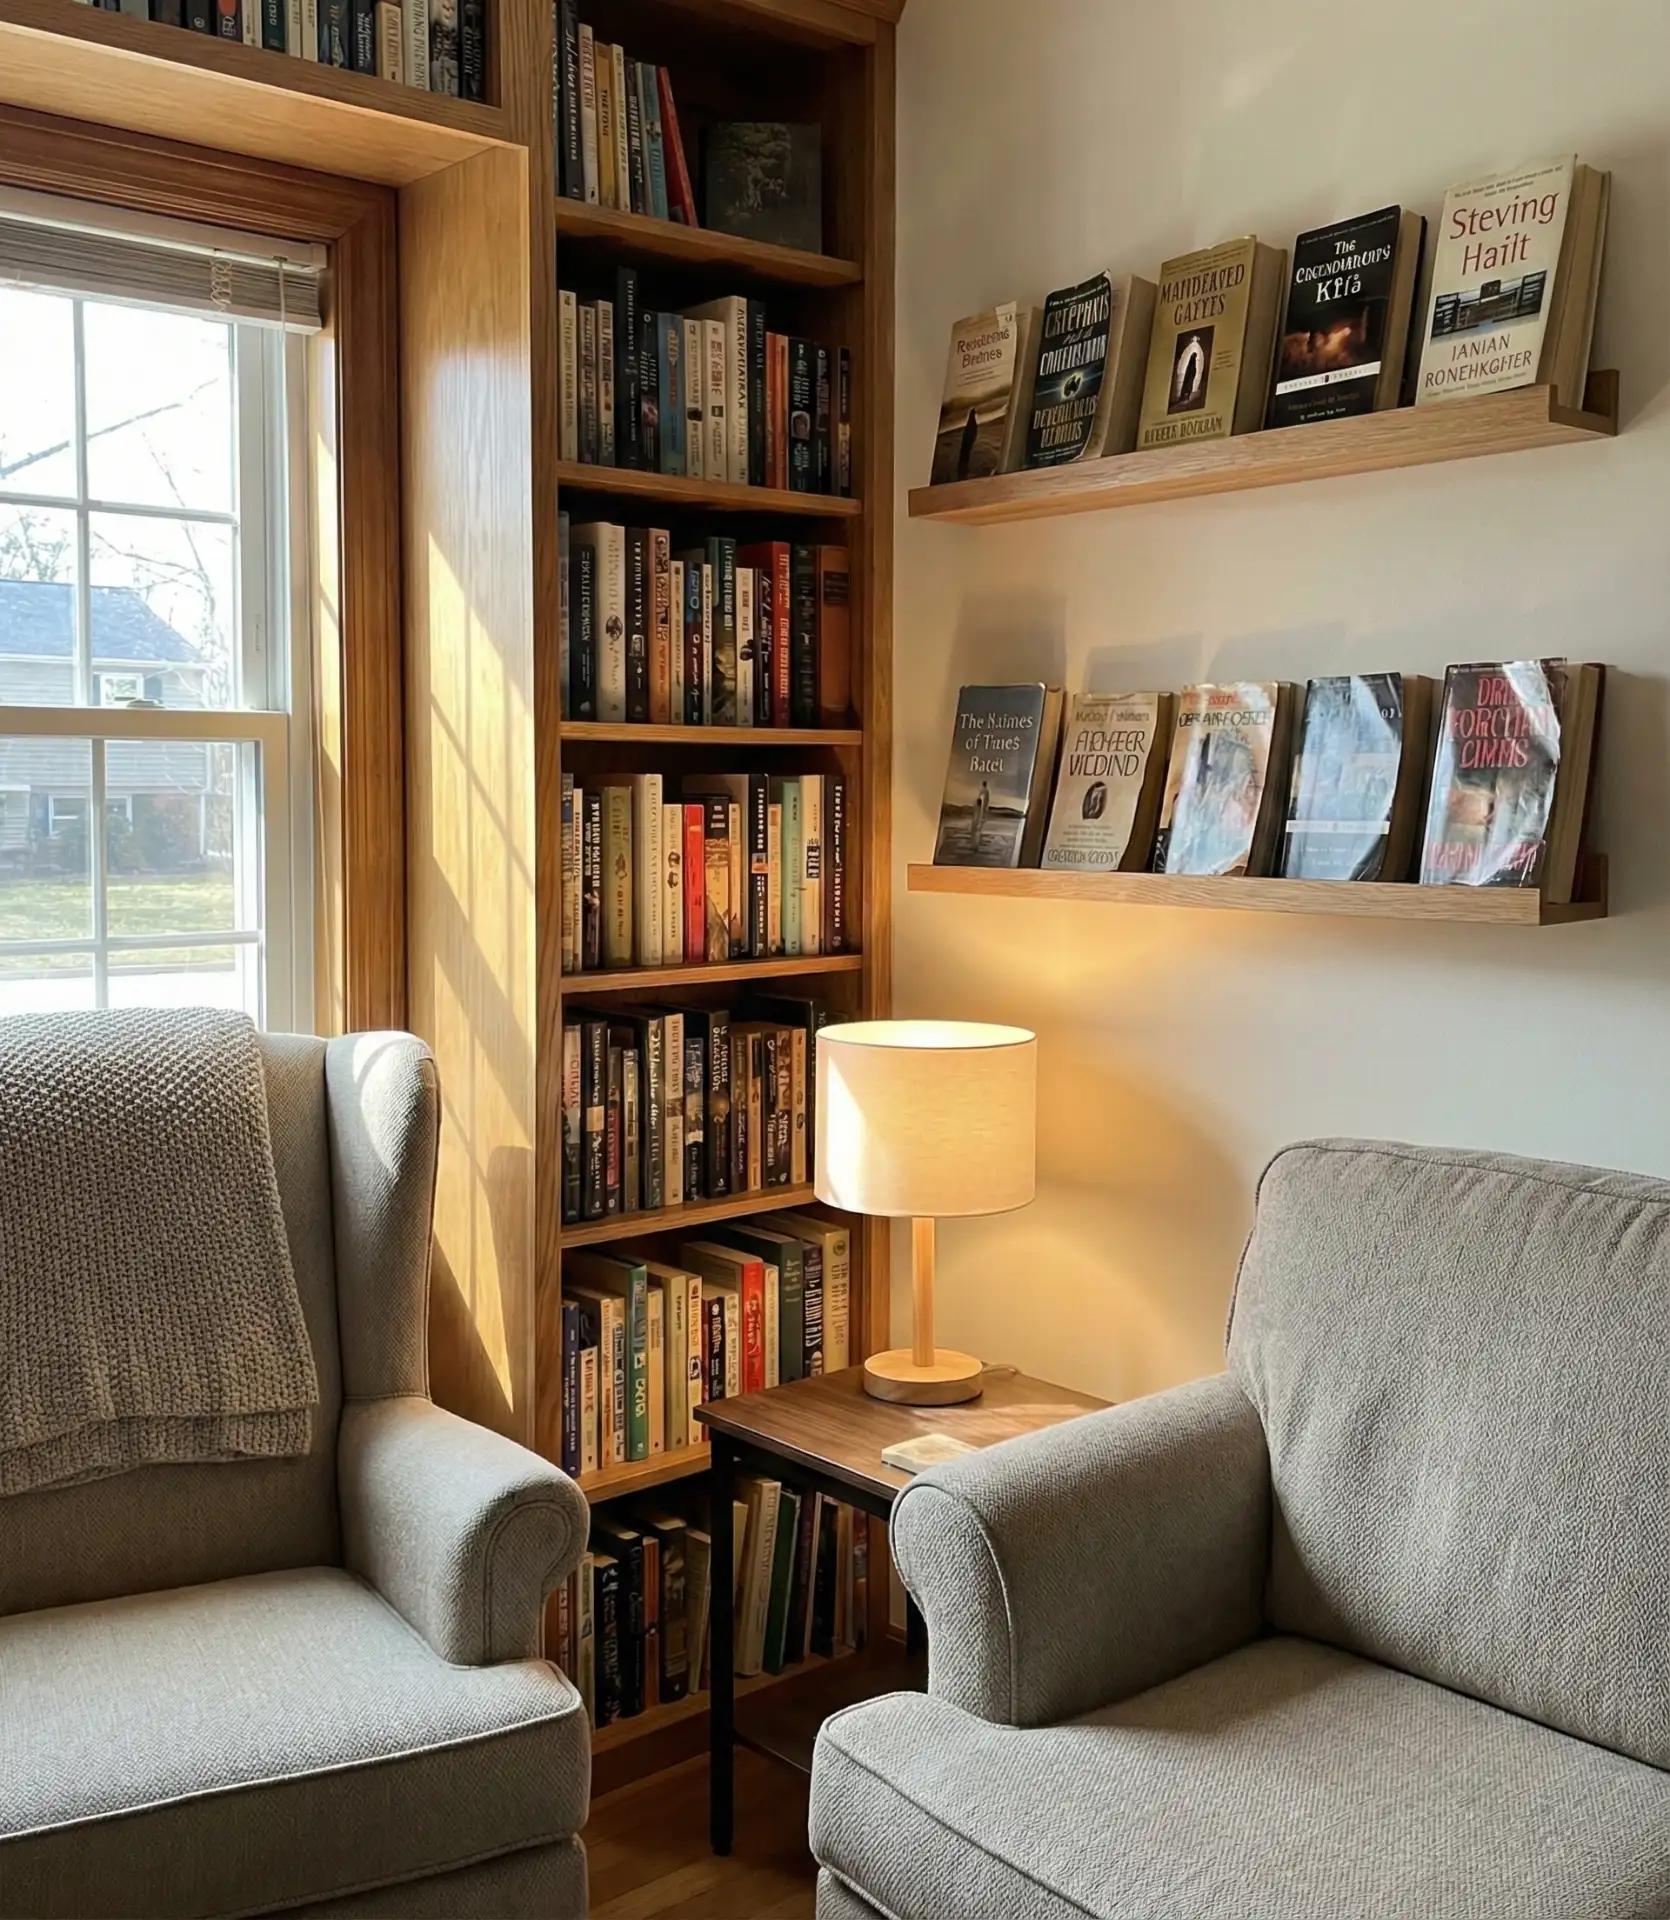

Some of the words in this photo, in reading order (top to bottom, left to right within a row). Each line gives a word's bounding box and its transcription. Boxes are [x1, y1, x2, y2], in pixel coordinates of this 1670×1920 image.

[1449, 191, 1560, 240] Steving
[1461, 232, 1531, 276] Hailt
[960, 713, 984, 729] The
[965, 733, 981, 750] of
